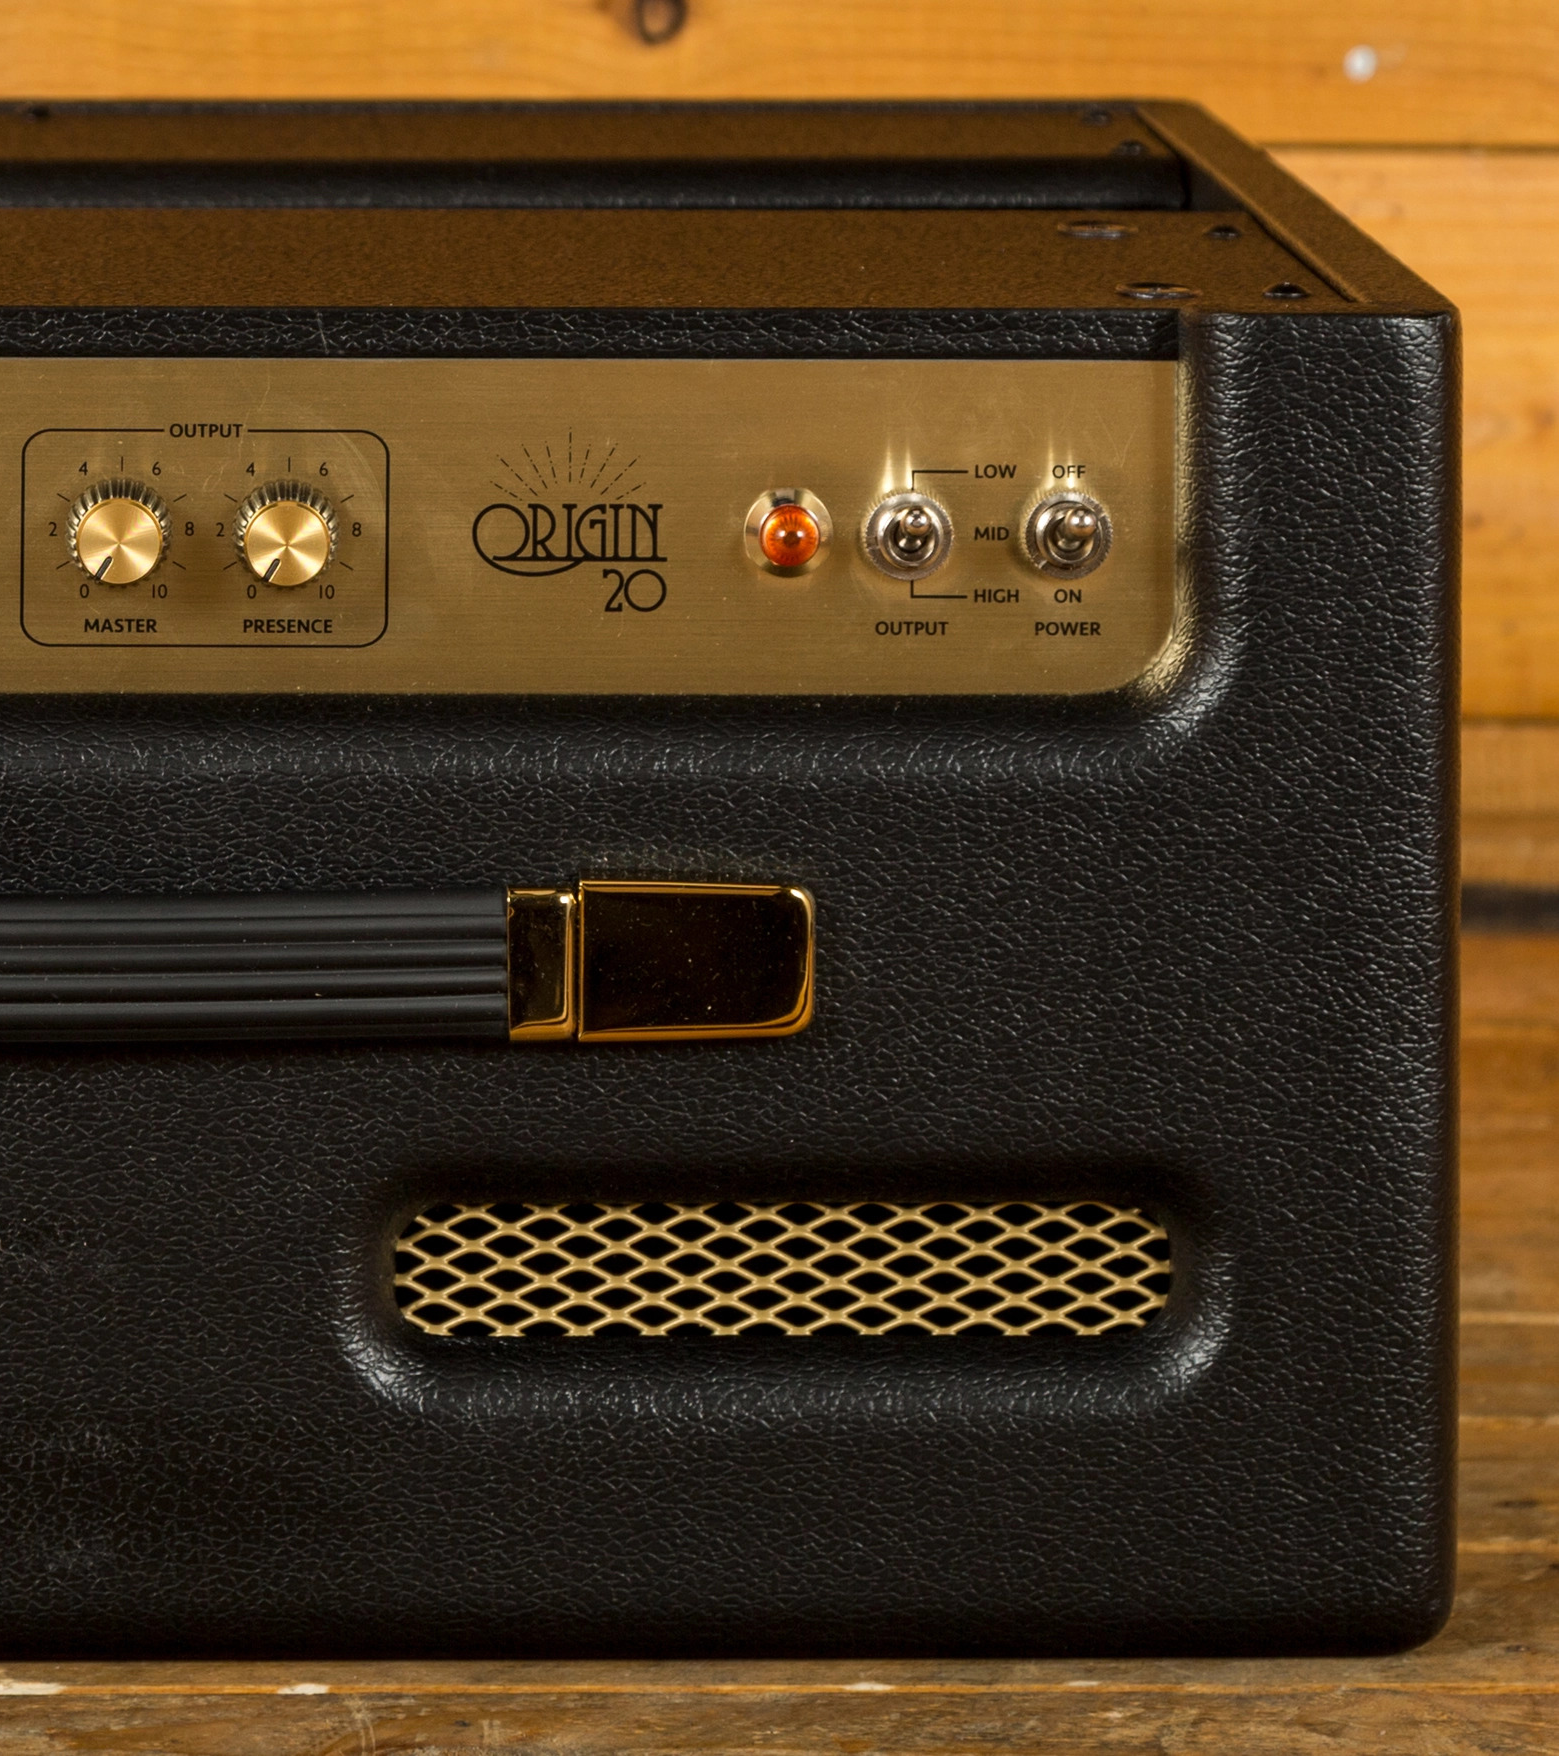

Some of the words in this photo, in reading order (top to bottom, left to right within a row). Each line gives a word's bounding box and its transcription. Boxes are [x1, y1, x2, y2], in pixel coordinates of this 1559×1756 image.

[169, 423, 243, 438] OUTPUT
[78, 461, 88, 476] 4
[151, 461, 162, 476] 6
[245, 462, 255, 477] 4
[318, 461, 329, 477] 6
[974, 464, 1017, 479] LOW
[1052, 464, 1087, 480] OFF
[48, 521, 58, 537] 2
[184, 521, 195, 537] 8
[215, 522, 225, 538] 2
[351, 521, 362, 538] 8
[974, 526, 1010, 541] MID
[472, 503, 668, 578] ORIGIN
[79, 583, 90, 599] 0
[152, 583, 168, 599] 10
[246, 584, 257, 600] 0
[319, 584, 335, 600] 10
[602, 568, 667, 613] 20
[973, 588, 1020, 604] HIGH
[1053, 588, 1082, 604] ON
[84, 618, 158, 633] MASTER
[243, 618, 333, 634] PRESENCE
[874, 620, 949, 636] OUTPUT
[1034, 621, 1101, 636] POWER
